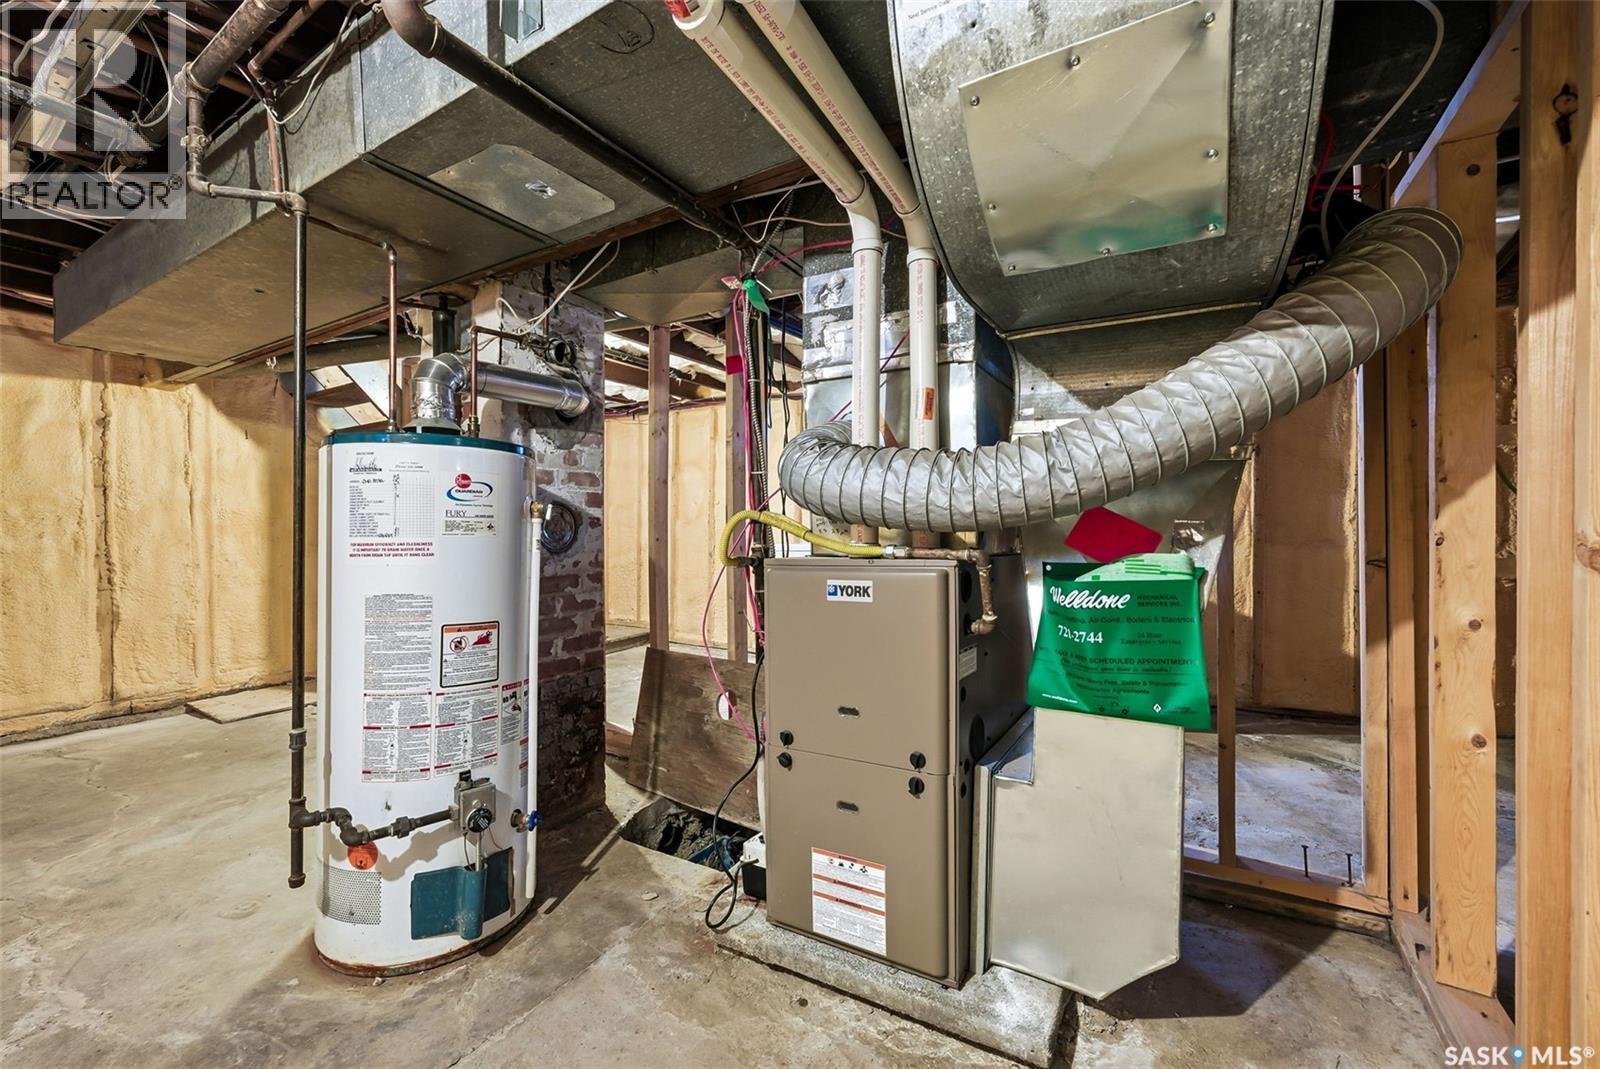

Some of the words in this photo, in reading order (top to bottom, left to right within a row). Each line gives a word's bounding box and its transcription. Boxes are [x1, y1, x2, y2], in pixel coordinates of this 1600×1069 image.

[445, 509, 467, 519] FURY
[838, 584, 871, 598] YORK
[1050, 586, 1131, 609] Welldone
[1057, 625, 1104, 643] 721-2744
